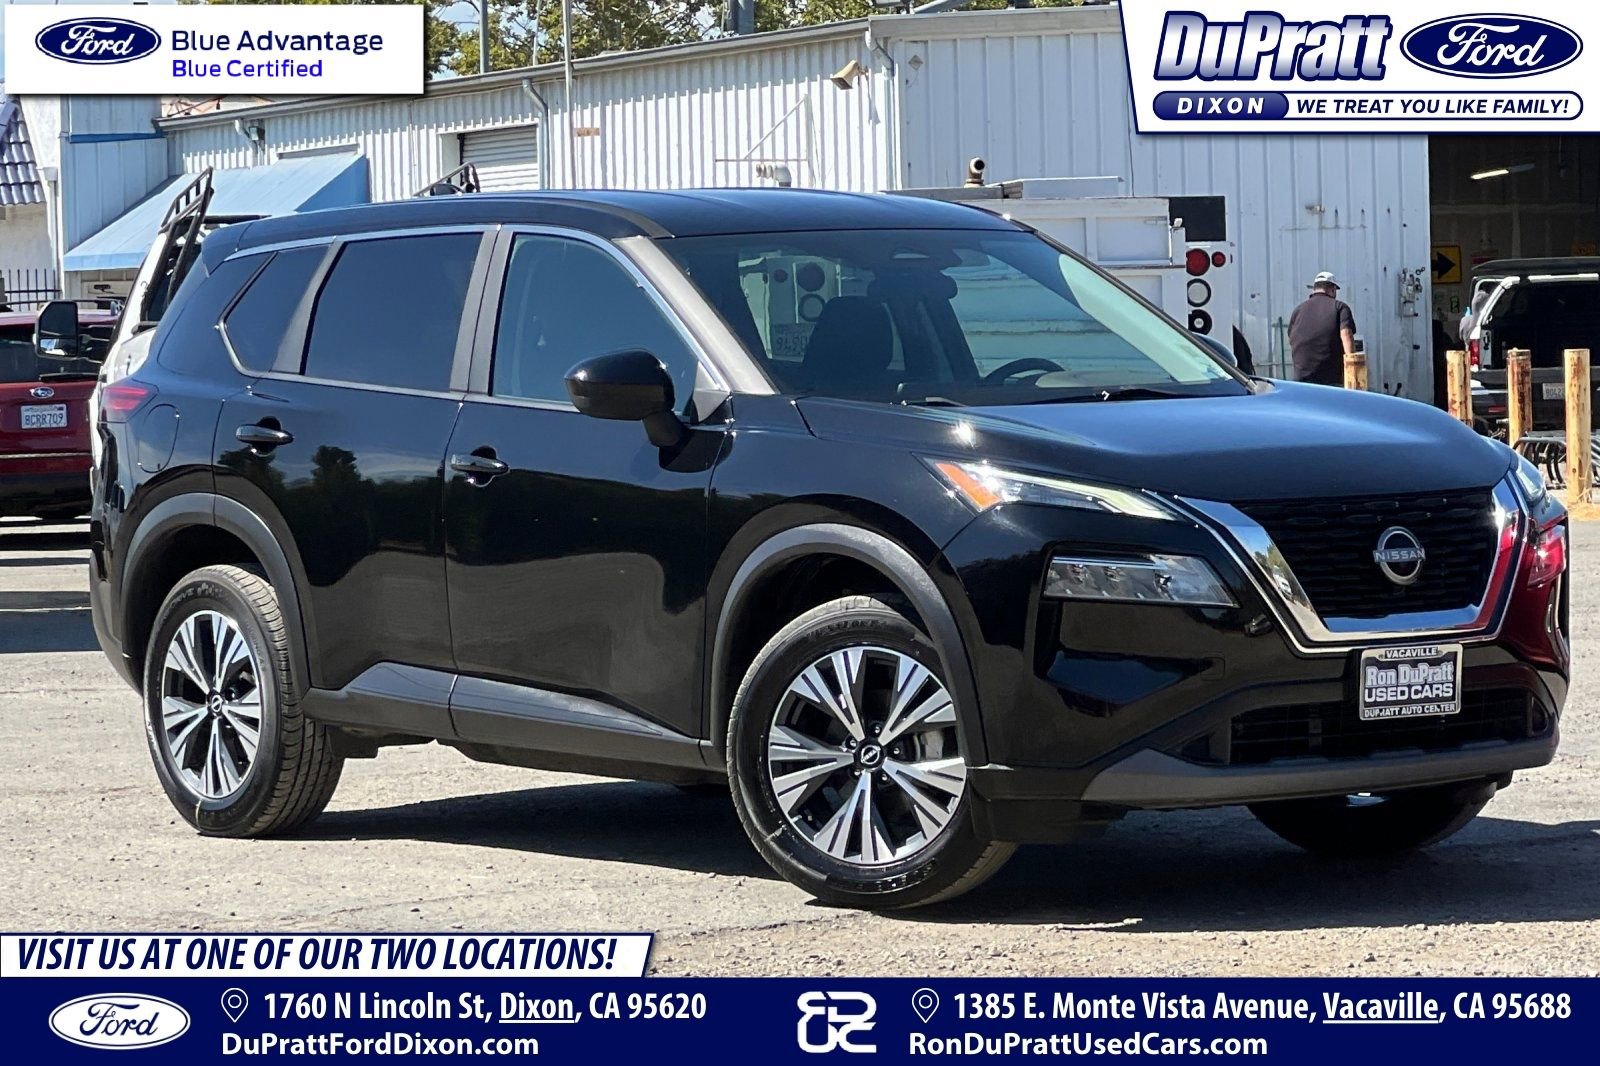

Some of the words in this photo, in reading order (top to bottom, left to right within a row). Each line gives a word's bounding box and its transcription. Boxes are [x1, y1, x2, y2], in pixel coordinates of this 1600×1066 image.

[25, 413, 64, 427] 8CRR709
[1375, 548, 1426, 562] NISSAN
[1386, 647, 1438, 659] VACAVILLE
[1366, 666, 1398, 688] Ron
[1397, 661, 1455, 686] DuPratt
[1364, 686, 1409, 703] USED
[1410, 682, 1454, 700] CARS
[1401, 706, 1423, 715] AUTO
